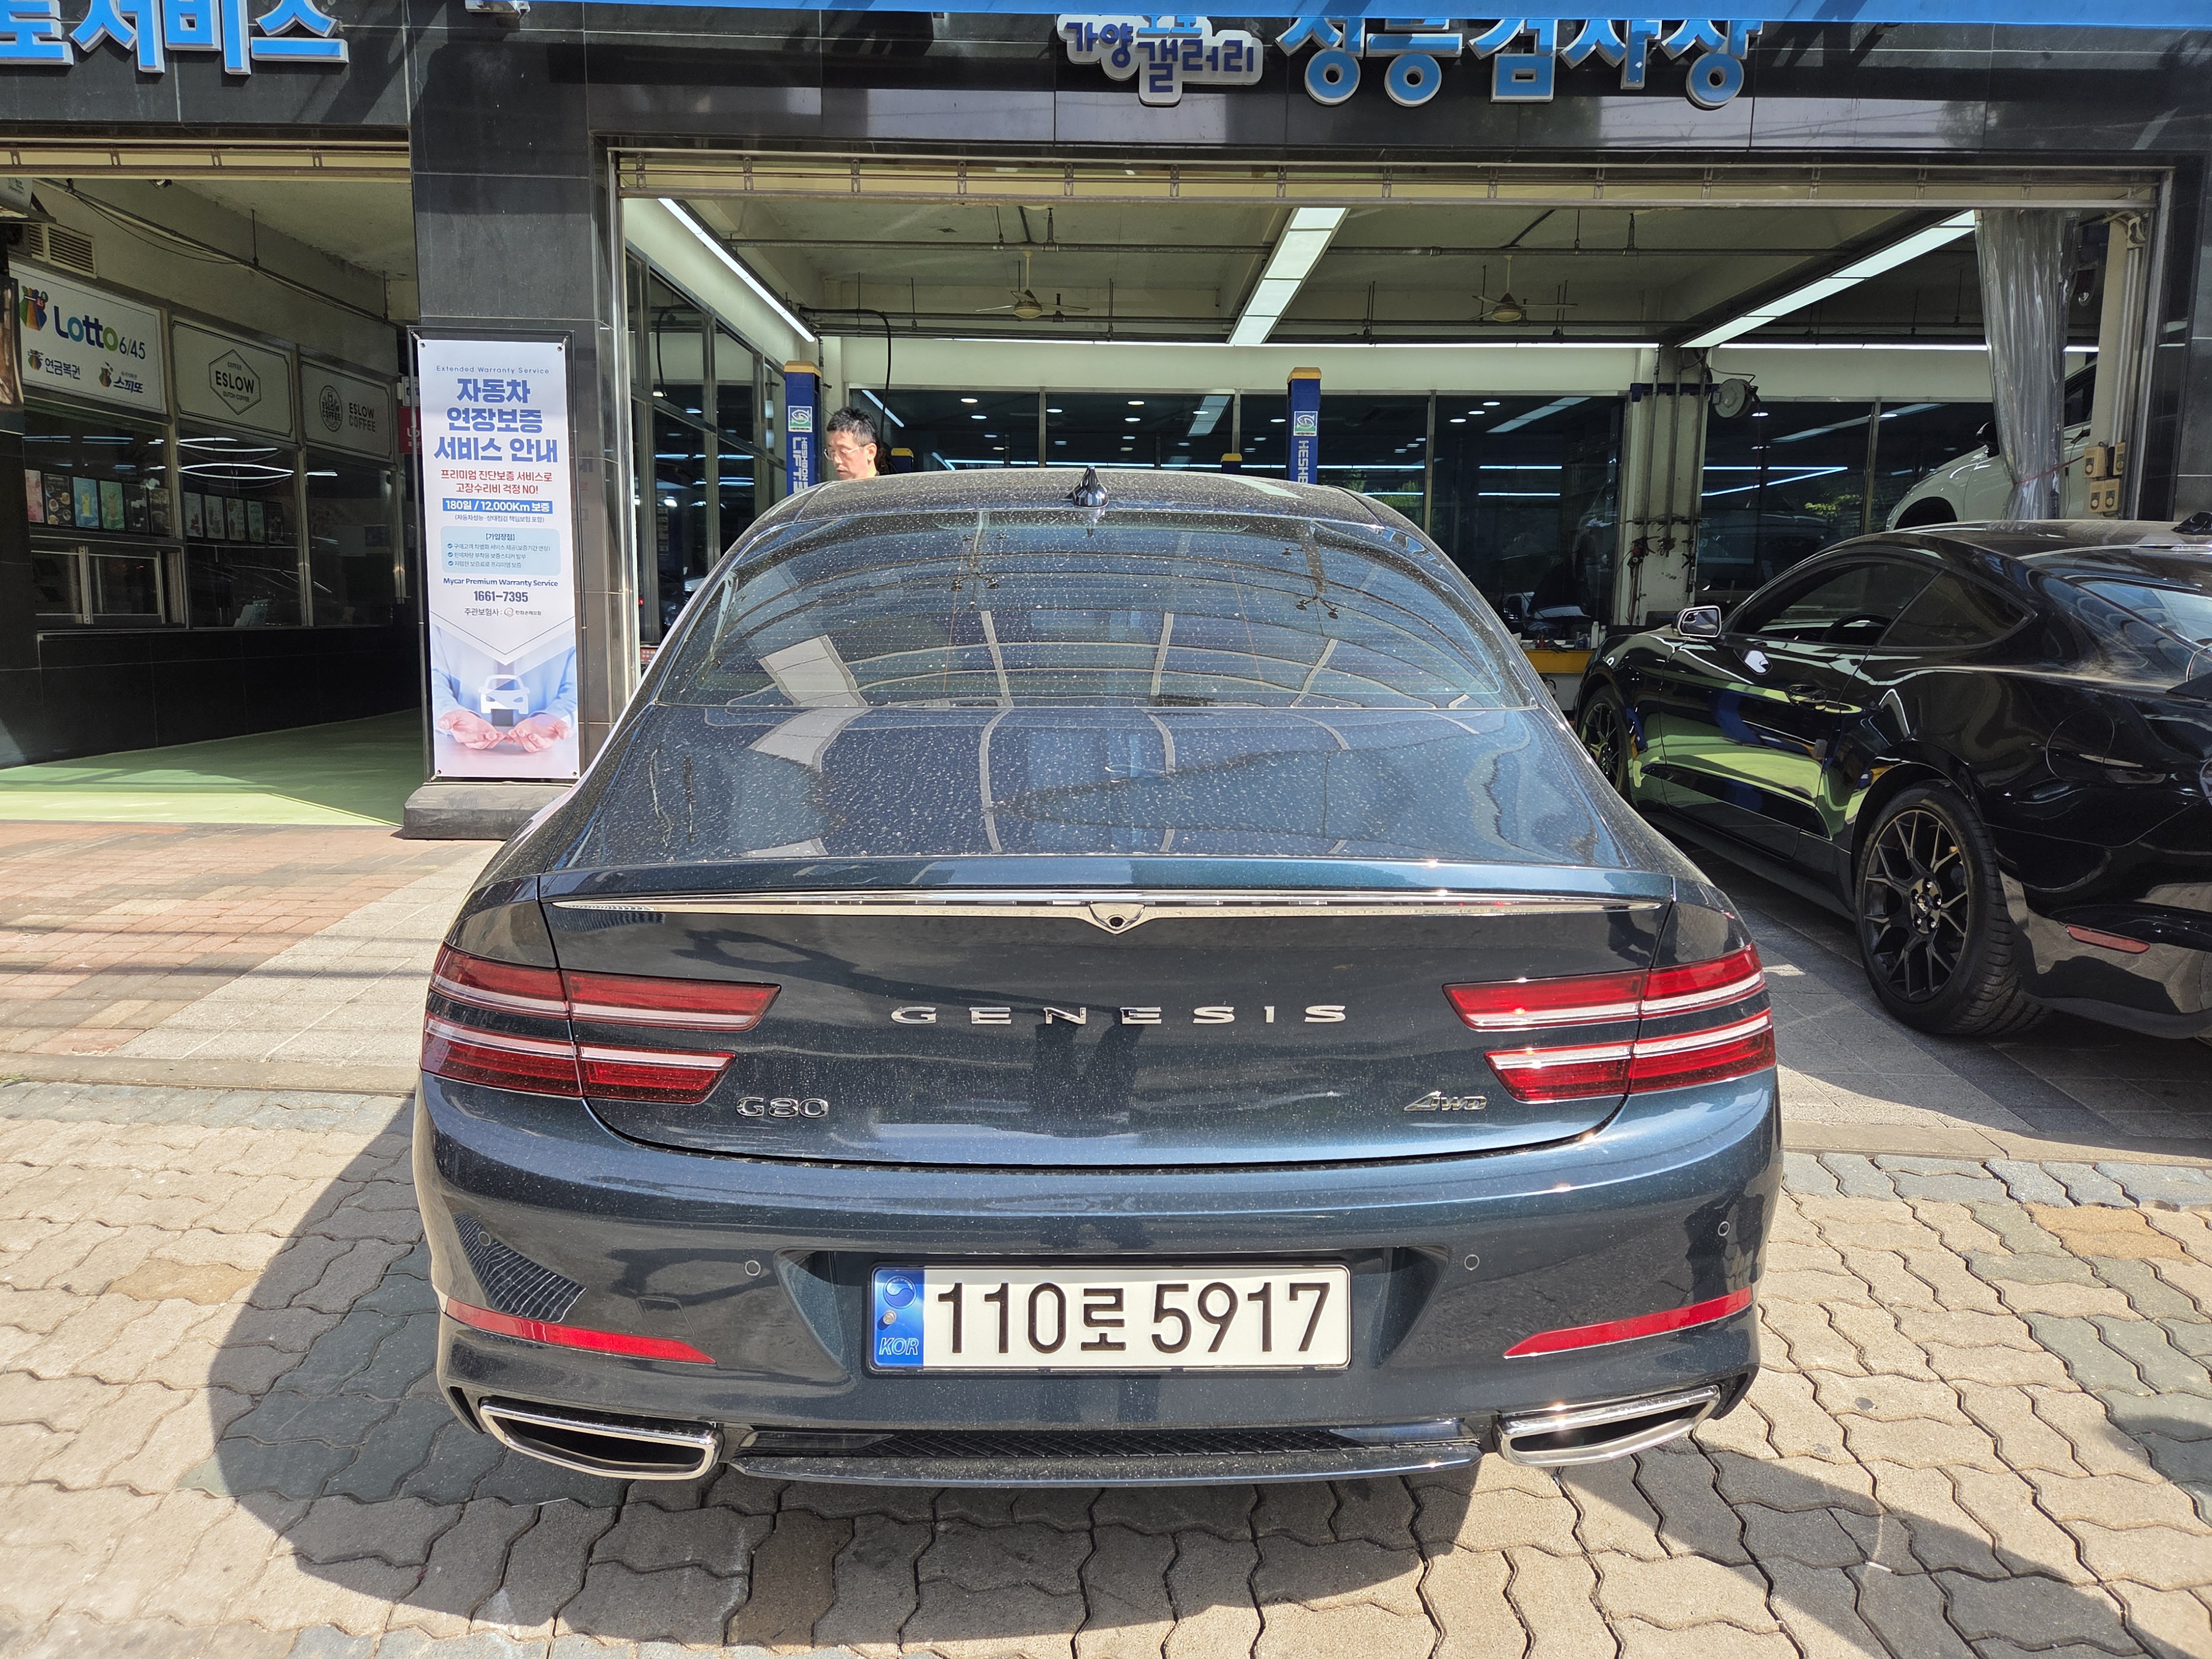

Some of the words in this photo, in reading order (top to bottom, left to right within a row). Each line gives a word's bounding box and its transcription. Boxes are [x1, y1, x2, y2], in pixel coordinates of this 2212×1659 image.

[1066, 22, 1133, 68] 가양
[1136, 38, 1254, 93] 갤러리
[54, 305, 118, 351] Lotto
[119, 336, 145, 359] 6/45
[45, 357, 80, 380] 연금복권
[113, 376, 144, 393] 스피또
[216, 370, 254, 394] ESLOW
[457, 378, 531, 403] 자동차
[349, 402, 374, 419] ESLOW
[447, 407, 542, 434] 연장보증
[349, 415, 376, 432] COFFEE
[434, 436, 503, 461] 서비스
[510, 438, 558, 463] 안내
[441, 469, 477, 480] 프리미엄
[478, 471, 515, 481] 진단보증
[517, 472, 552, 482] 서비스로
[456, 483, 500, 494] 고장수리비
[503, 484, 520, 494] 걱정
[523, 484, 538, 494] NO!
[446, 500, 472, 510] 180일
[481, 501, 530, 512] 12,000Km
[531, 502, 550, 512] 보증
[498, 579, 532, 587] Warranty
[473, 591, 528, 602] 1661-7395
[464, 608, 499, 616] 주관보험사
[891, 1005, 1347, 1025] GENESIS
[737, 1097, 829, 1118] G80
[1404, 1091, 1487, 1112] 4WD
[938, 1282, 1126, 1354] 110로
[1151, 1282, 1331, 1354] 5917
[879, 1337, 919, 1355] KOR
